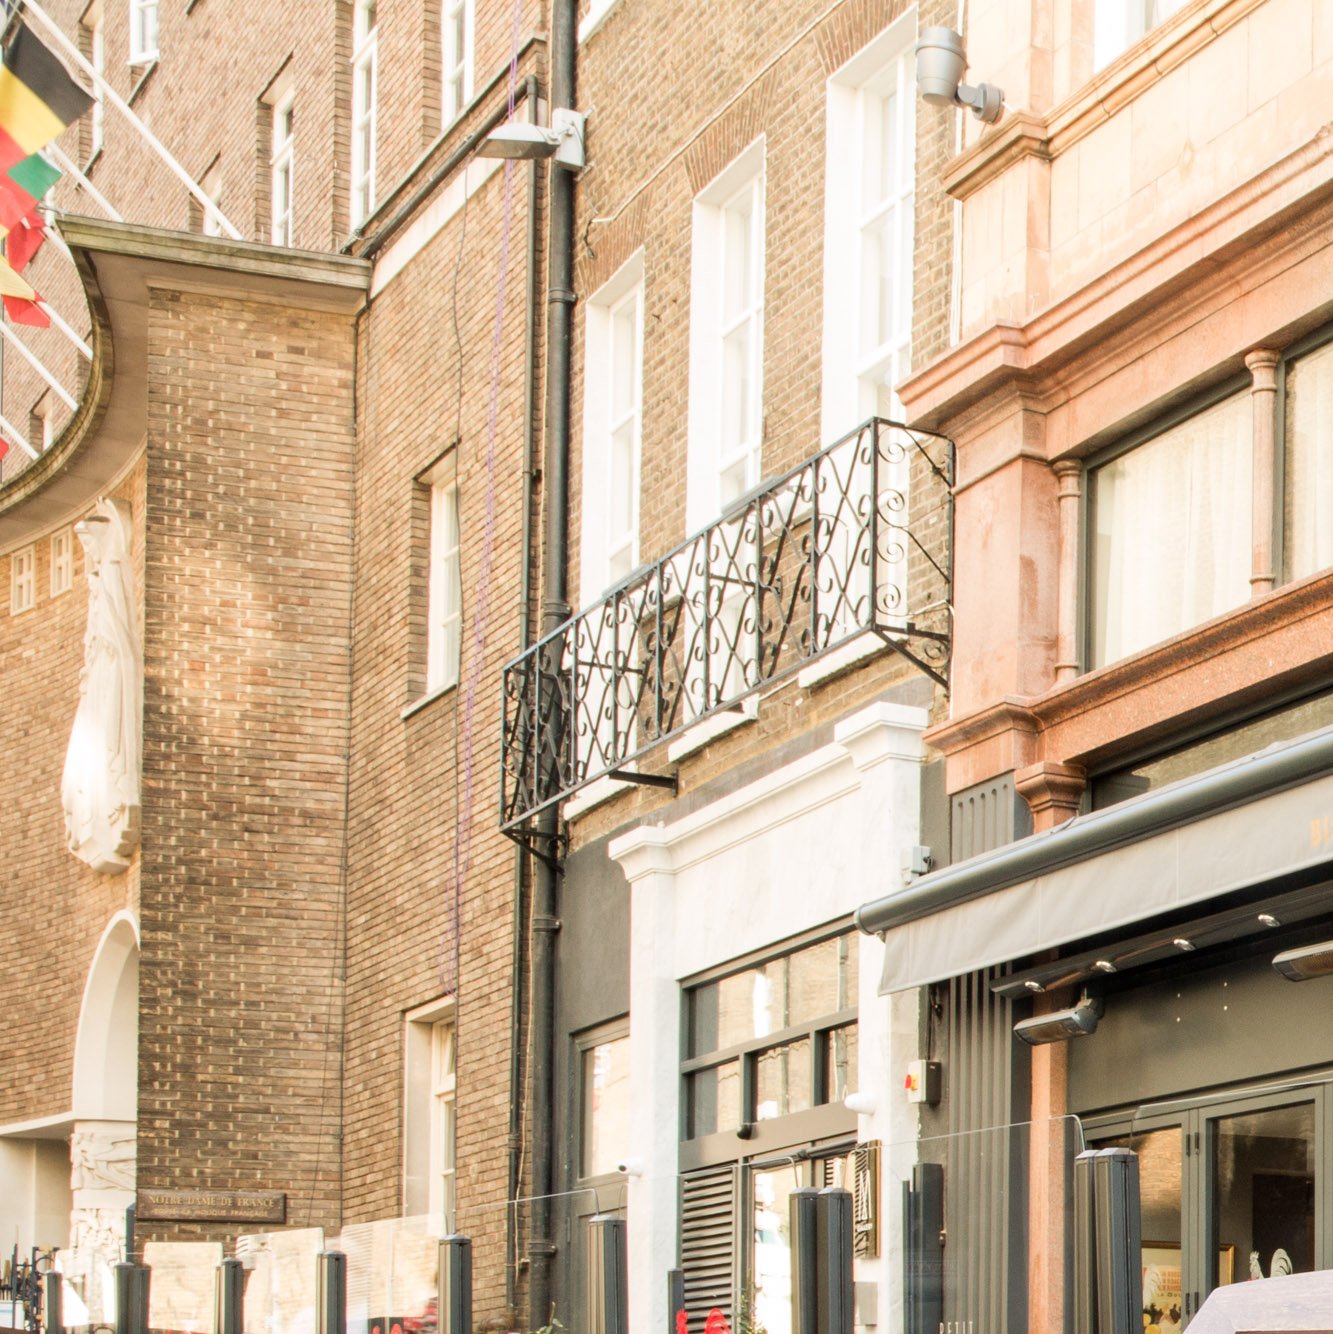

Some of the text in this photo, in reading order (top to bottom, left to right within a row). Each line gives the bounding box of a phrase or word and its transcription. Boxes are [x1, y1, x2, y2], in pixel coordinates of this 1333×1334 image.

[150, 1195, 275, 1208] NOTRE DAME DE FRANCE
